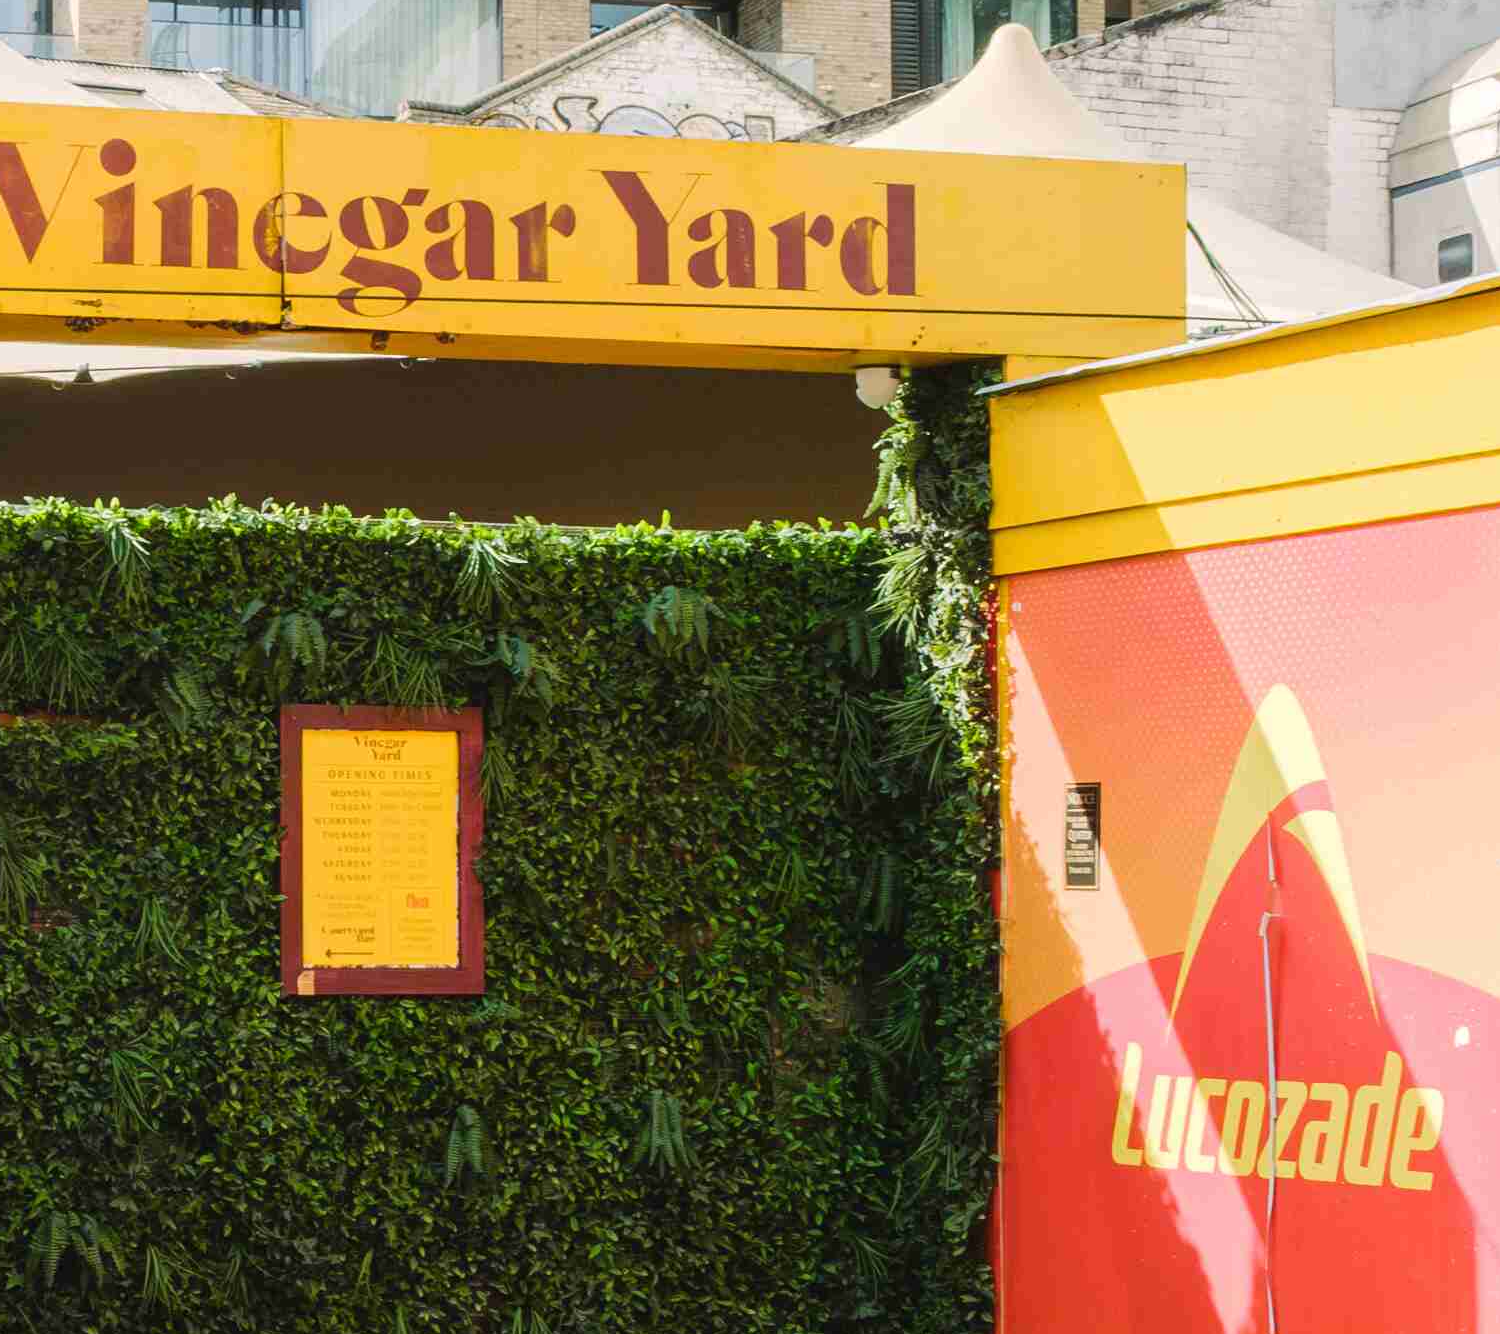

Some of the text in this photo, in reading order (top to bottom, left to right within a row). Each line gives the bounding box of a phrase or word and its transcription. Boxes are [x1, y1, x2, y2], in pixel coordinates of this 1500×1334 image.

[589, 168, 925, 298] Yard
[327, 769, 433, 780] OPENING TIMES
[1111, 1042, 1445, 1191] Lucozade
